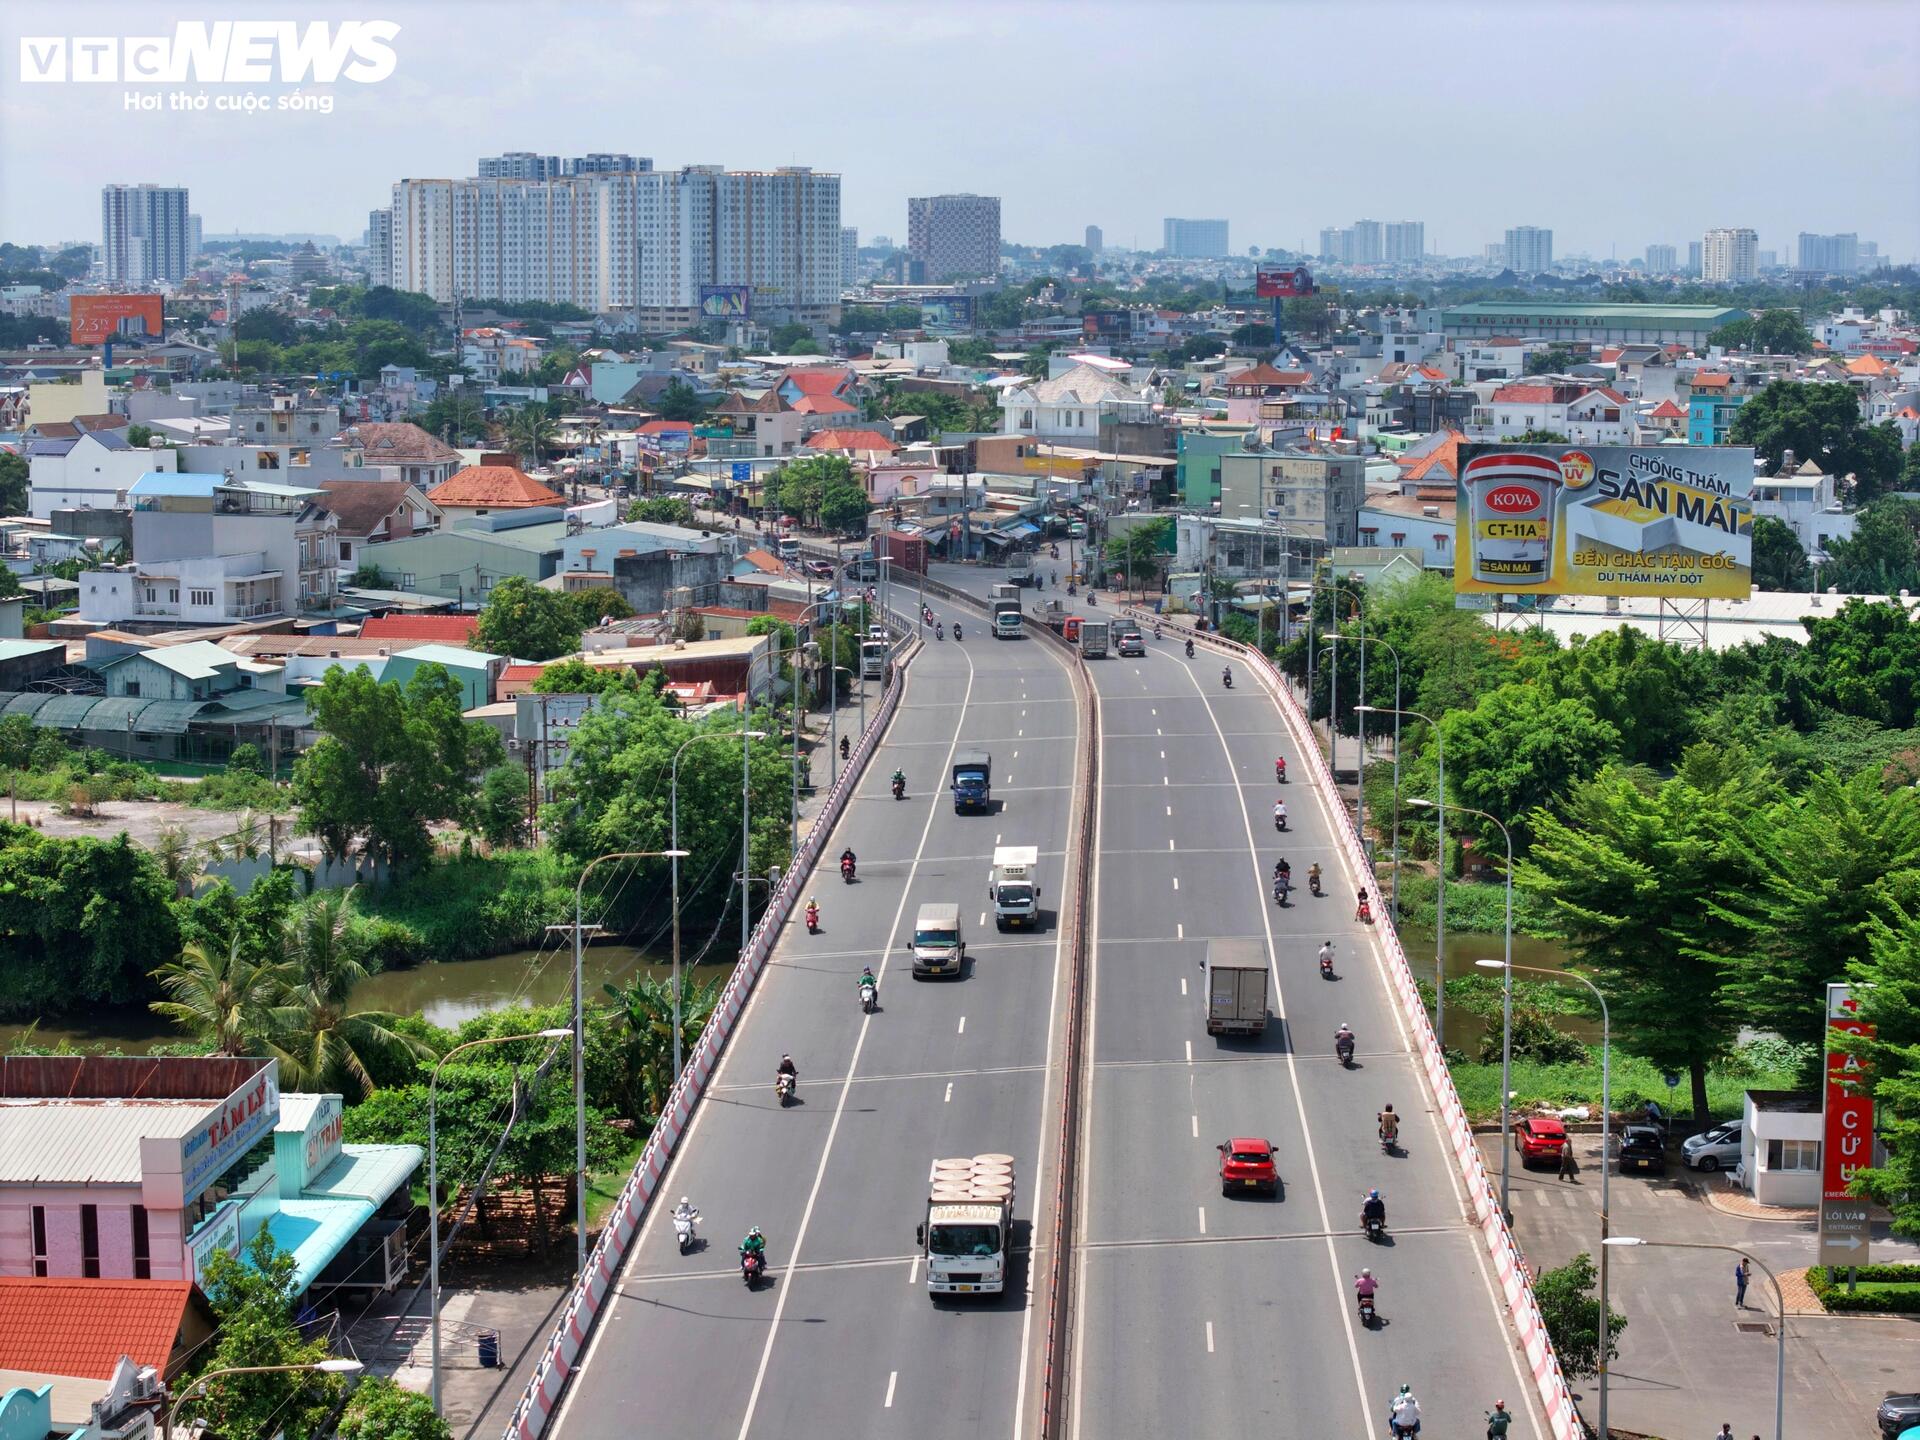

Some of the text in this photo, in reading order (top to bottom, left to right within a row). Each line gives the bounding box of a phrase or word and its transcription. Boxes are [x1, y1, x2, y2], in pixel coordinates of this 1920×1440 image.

[1565, 469, 1584, 480] UV
[1629, 454, 1731, 496] CHỐNG THẤM
[1493, 494, 1533, 506] KOVA
[1598, 469, 1738, 535] SÀN MÁI
[1488, 524, 1537, 537] CT-11A
[1573, 549, 1736, 571] BỀN CHẮC TẬN GỐC
[1618, 571, 1651, 583] THẤM
[1654, 574, 1677, 583] HAY
[1680, 574, 1704, 586] DỘT
[208, 1104, 246, 1149] TÁM
